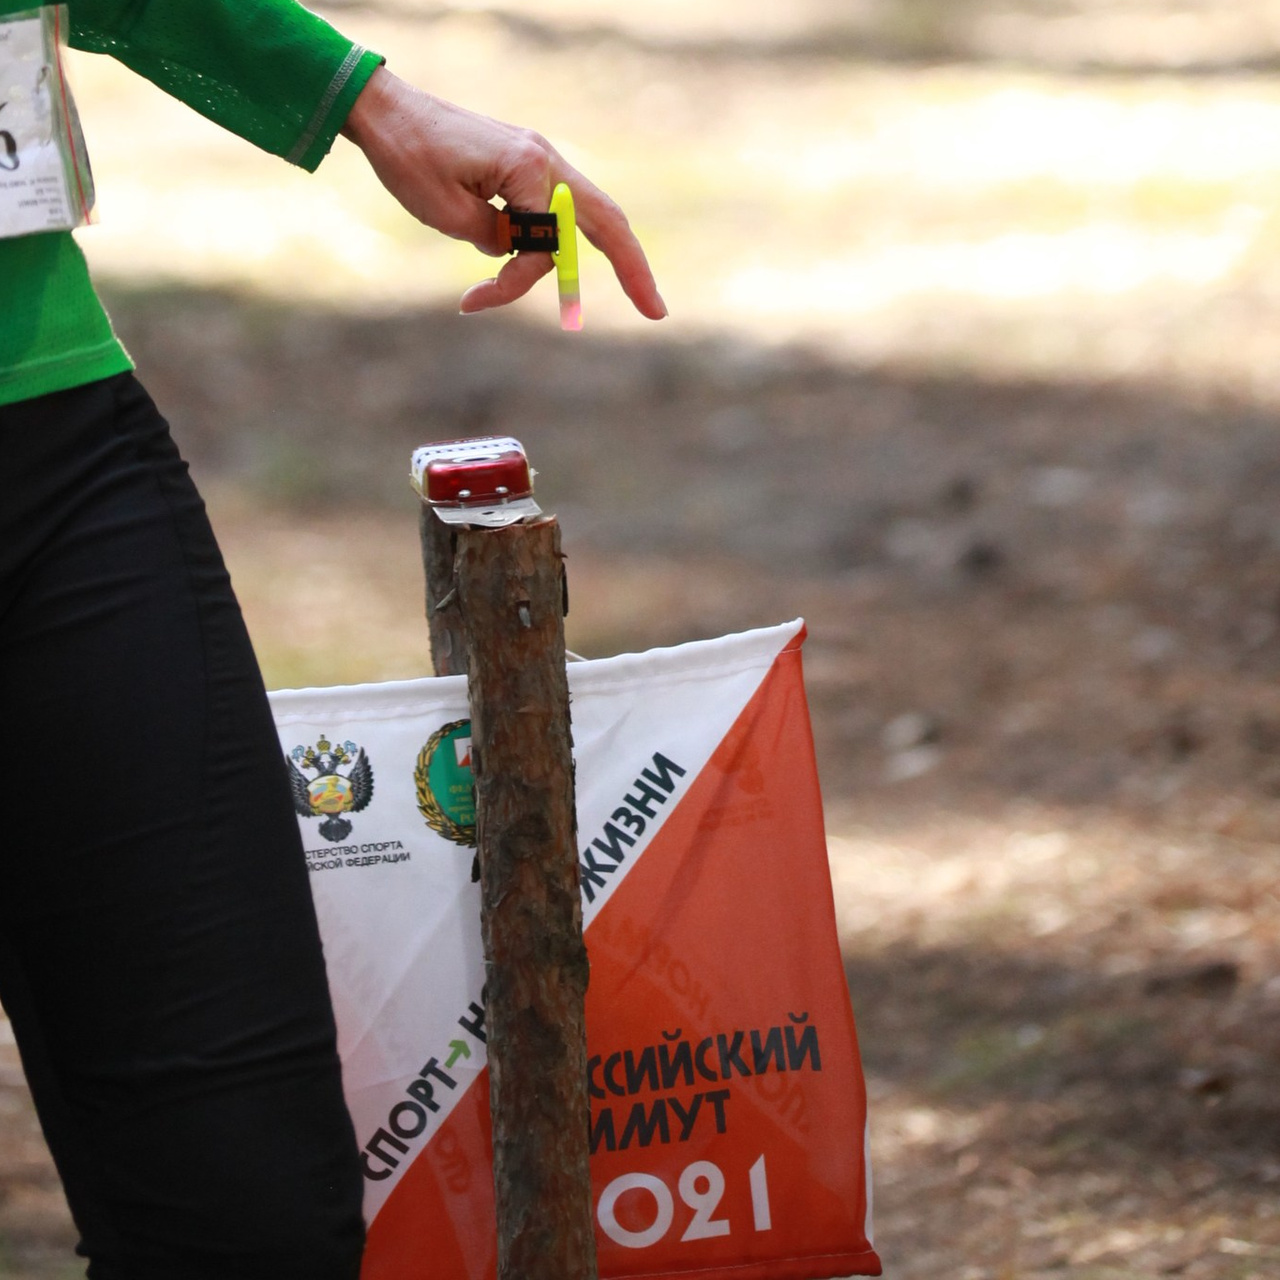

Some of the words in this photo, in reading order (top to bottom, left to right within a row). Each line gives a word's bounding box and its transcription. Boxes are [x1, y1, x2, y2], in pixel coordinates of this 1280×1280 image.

[345, 852, 411, 868] ФЕДЕРАЦИИ
[360, 840, 404, 854] СПОРТА
[580, 751, 687, 904] ЖИЗНИ
[359, 1056, 458, 1181] СПОРТ
[597, 1153, 772, 1249] 021
